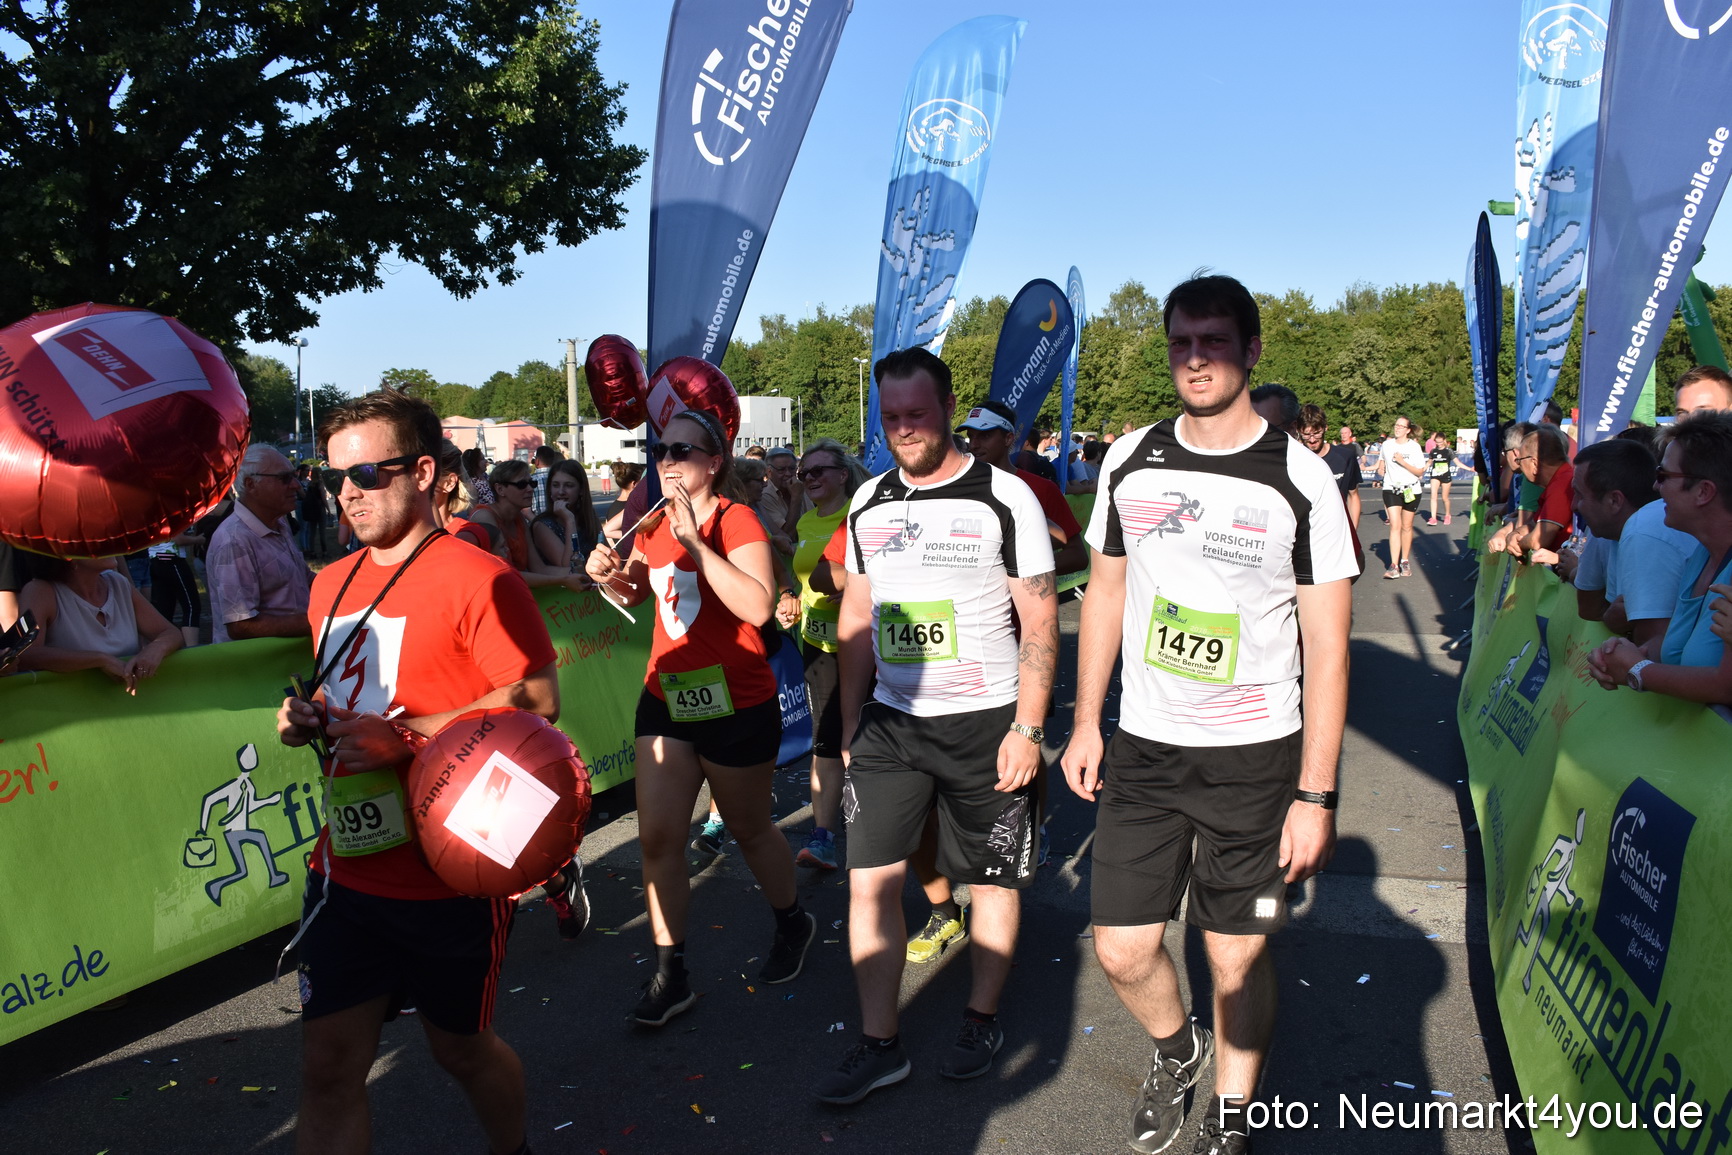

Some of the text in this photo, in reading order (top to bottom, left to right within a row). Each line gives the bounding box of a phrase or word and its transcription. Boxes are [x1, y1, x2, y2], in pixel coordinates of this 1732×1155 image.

[1595, 126, 1730, 433] www.fischer-automobile.de
[82, 344, 127, 370] DEHN
[924, 542, 982, 553] VORSICHT!
[1204, 530, 1266, 551] VORSICHT!
[922, 554, 979, 564] Freilaufende
[1202, 544, 1263, 564] Freilaufende
[572, 613, 629, 661] länger!
[805, 616, 828, 636] 951
[886, 622, 945, 646] 1466
[1157, 624, 1224, 664] 1479
[1157, 650, 1181, 664] Krämer
[1182, 658, 1217, 671] Bernhard
[676, 687, 713, 708] 430
[455, 720, 496, 763] DEHN
[333, 801, 383, 835] 399
[351, 828, 391, 843] Alexander
[1618, 831, 1667, 894] Fischer
[1619, 869, 1660, 913] AUTOMOBILE
[1534, 984, 1595, 1085] neumarkt
